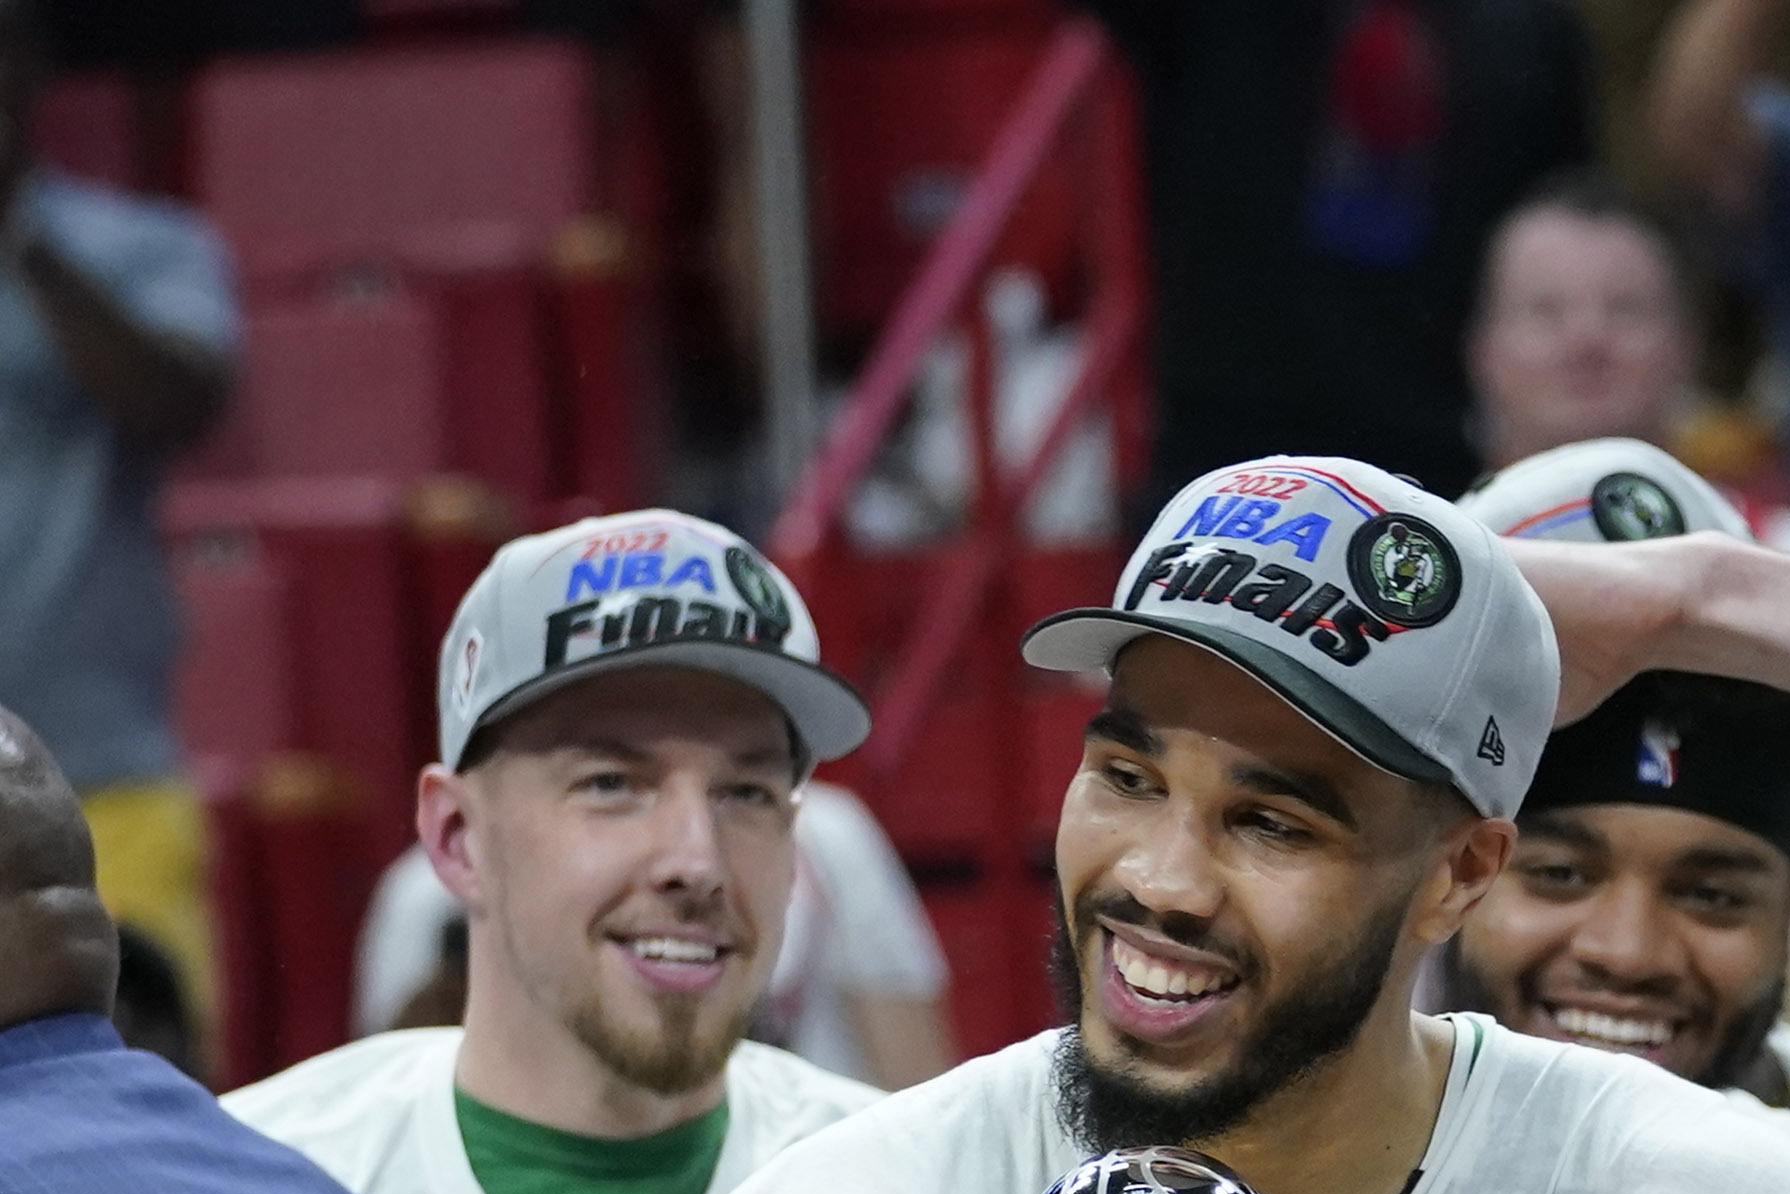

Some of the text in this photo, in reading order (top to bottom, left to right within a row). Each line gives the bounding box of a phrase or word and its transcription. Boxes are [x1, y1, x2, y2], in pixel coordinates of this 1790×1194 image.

[1218, 474, 1308, 500] 2022
[581, 531, 669, 560] 2022
[1174, 496, 1332, 562] NBA
[566, 553, 716, 602] NBA
[1126, 542, 1389, 666] Finals
